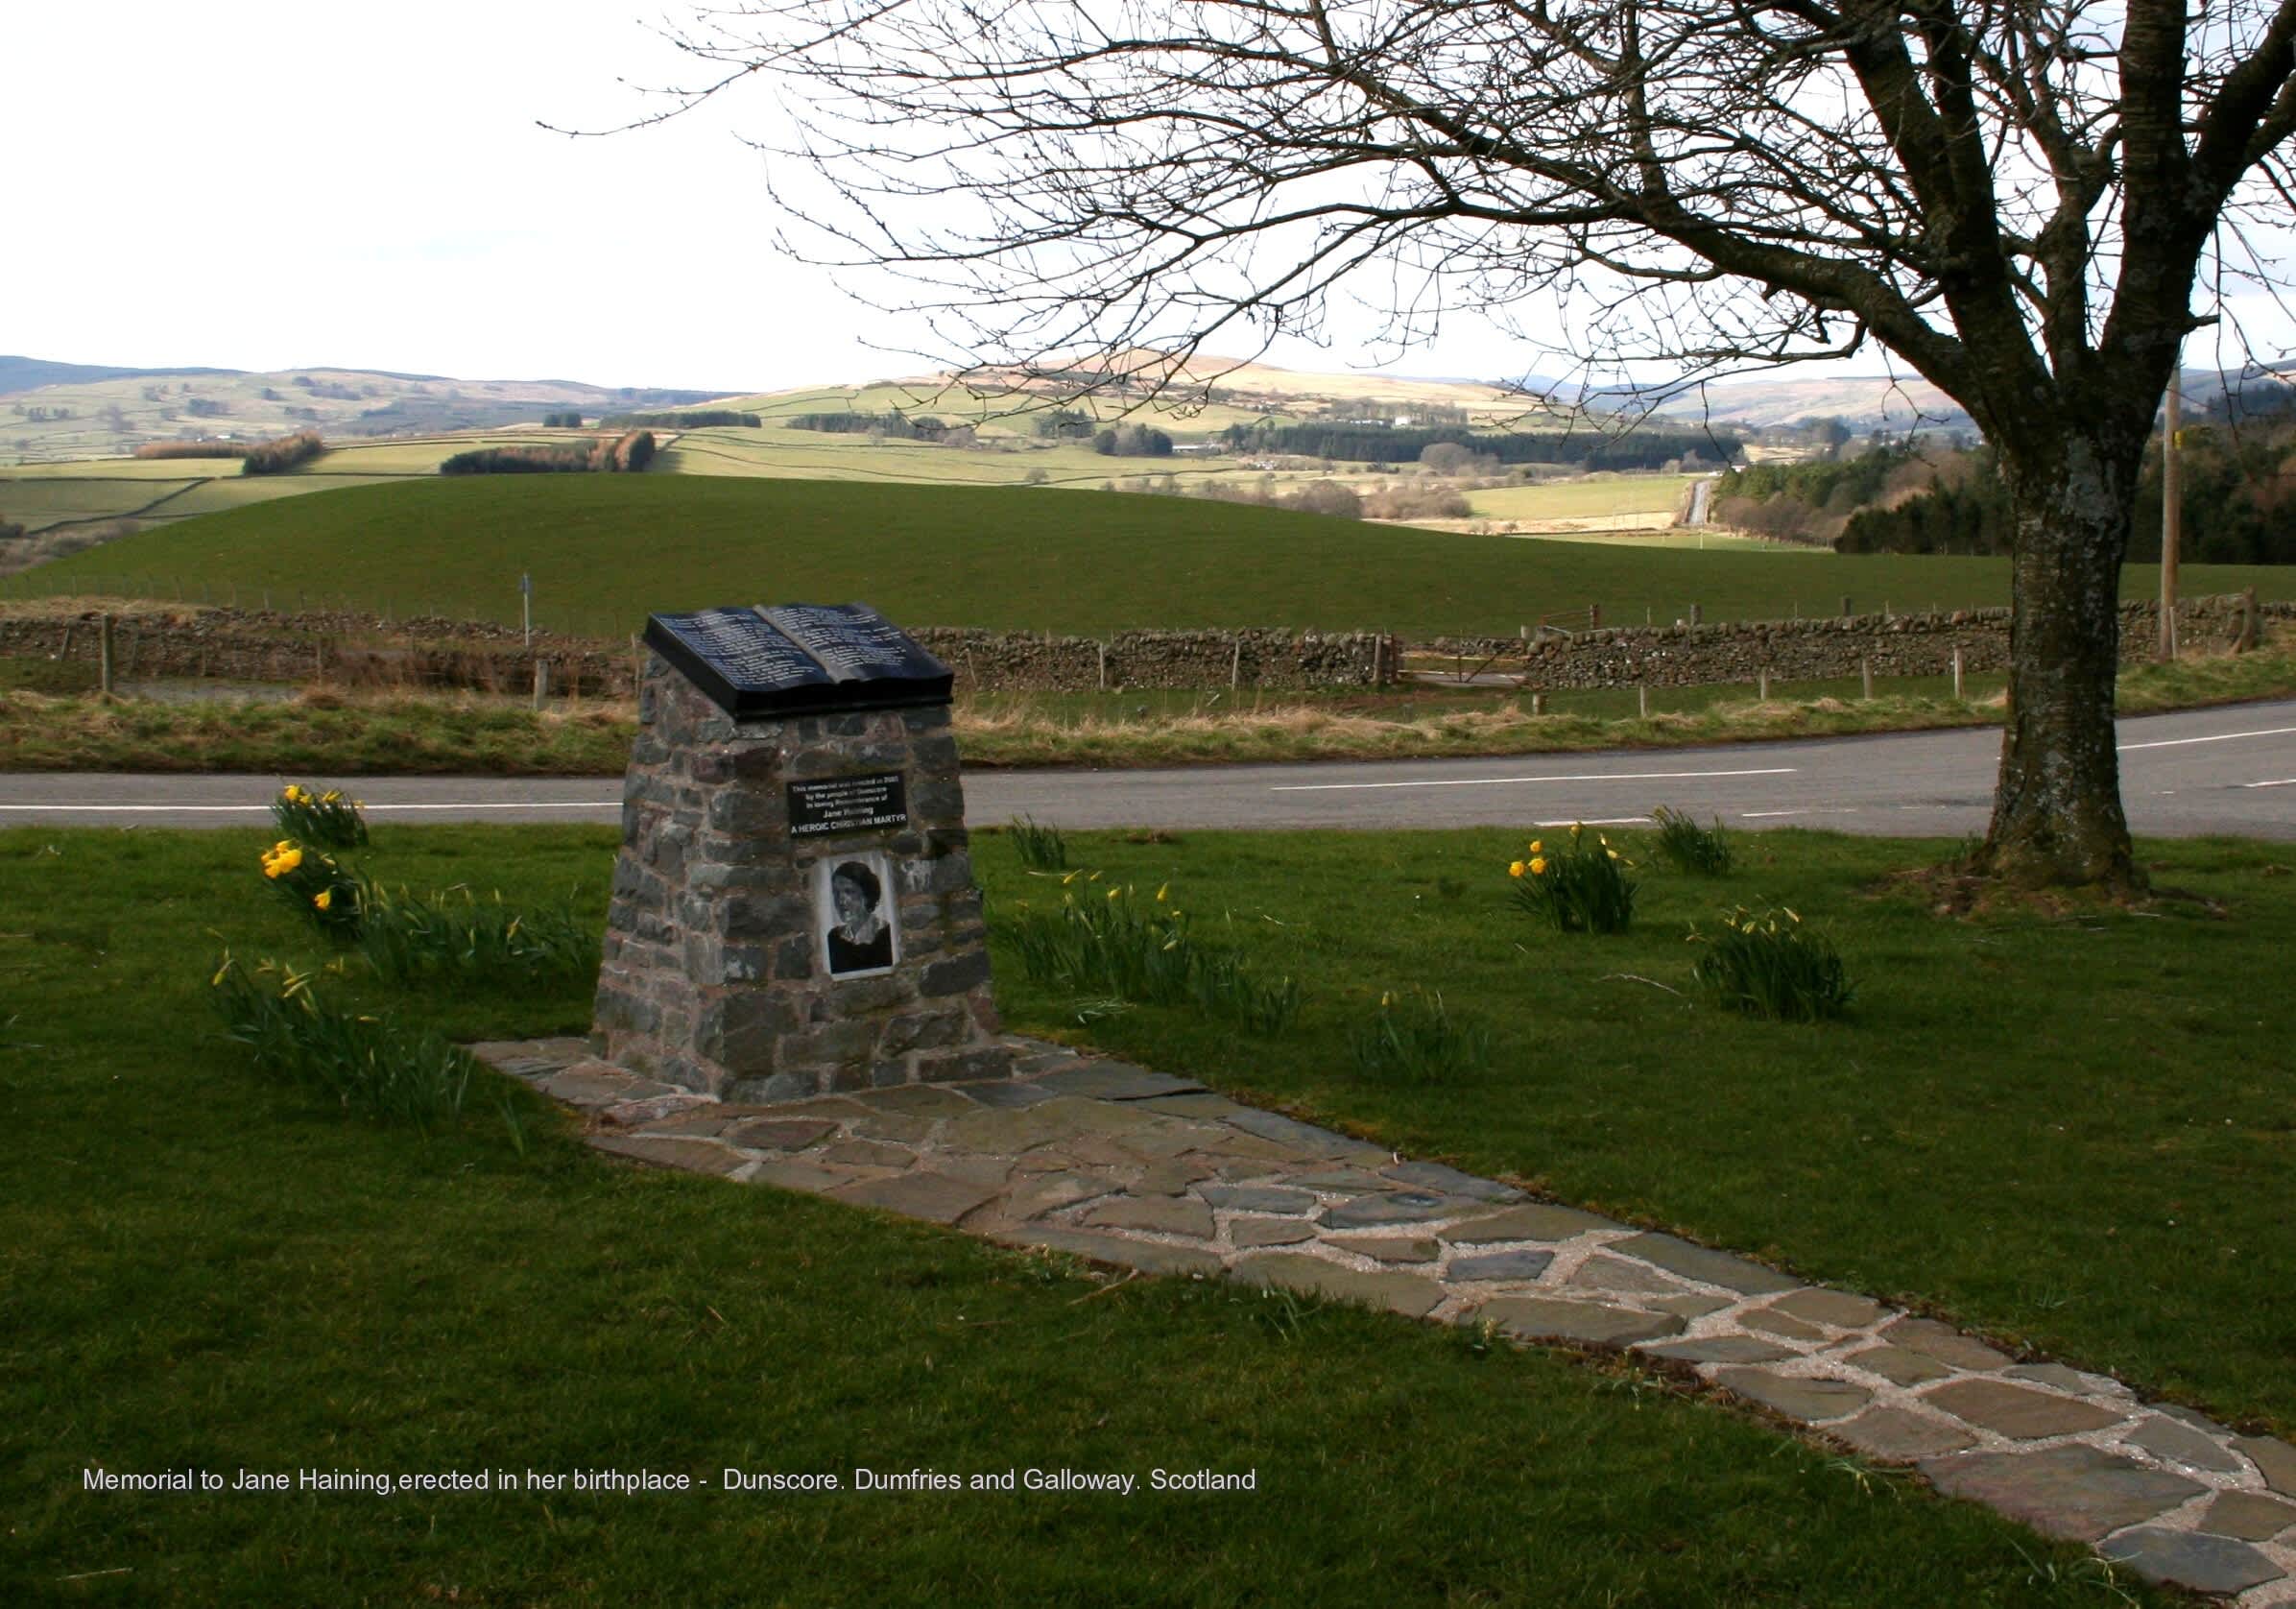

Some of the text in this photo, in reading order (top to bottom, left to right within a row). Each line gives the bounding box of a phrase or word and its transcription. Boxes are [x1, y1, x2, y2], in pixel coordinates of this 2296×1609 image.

[823, 809, 843, 819] Jane
[791, 826, 798, 834] A
[799, 822, 829, 833] HEROIC
[873, 813, 907, 825] MARTYR
